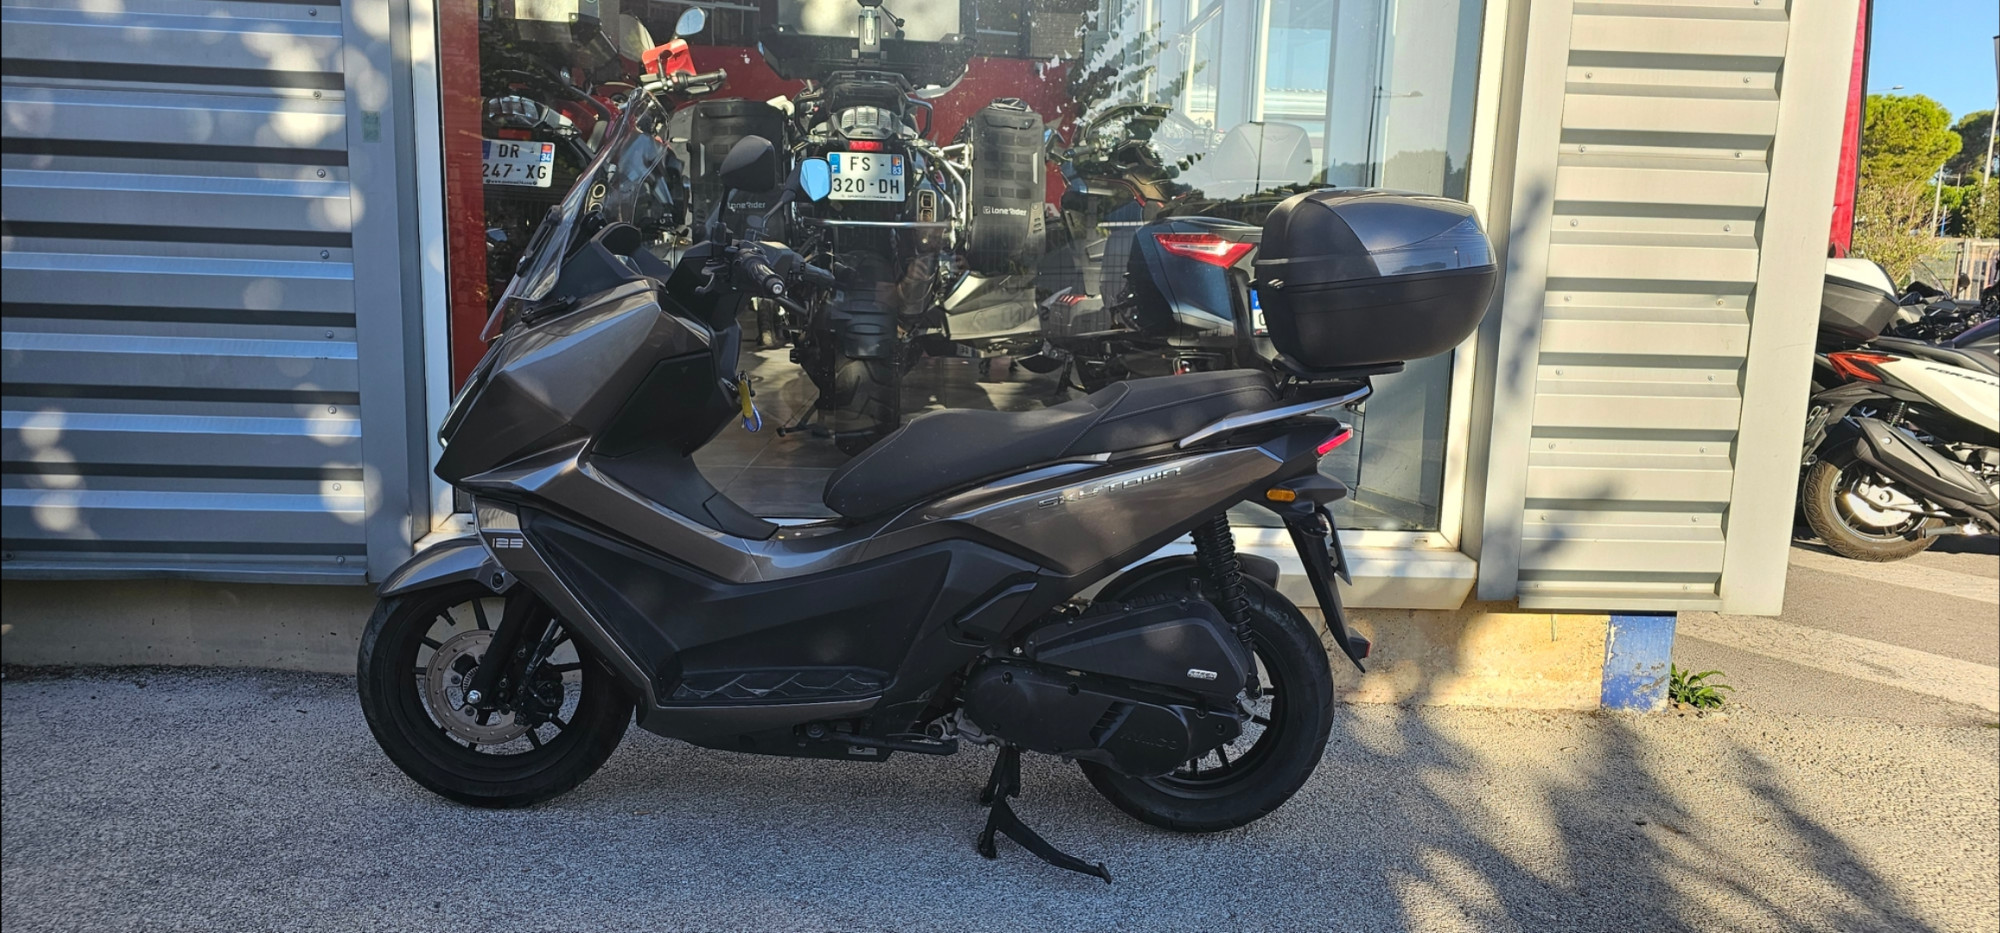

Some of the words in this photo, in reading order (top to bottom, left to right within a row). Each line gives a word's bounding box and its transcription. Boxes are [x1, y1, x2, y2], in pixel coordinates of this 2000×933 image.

[499, 144, 520, 158] DR
[541, 153, 551, 162] 34
[850, 156, 871, 171] FS
[891, 166, 902, 175] 83
[491, 537, 524, 549] 125
